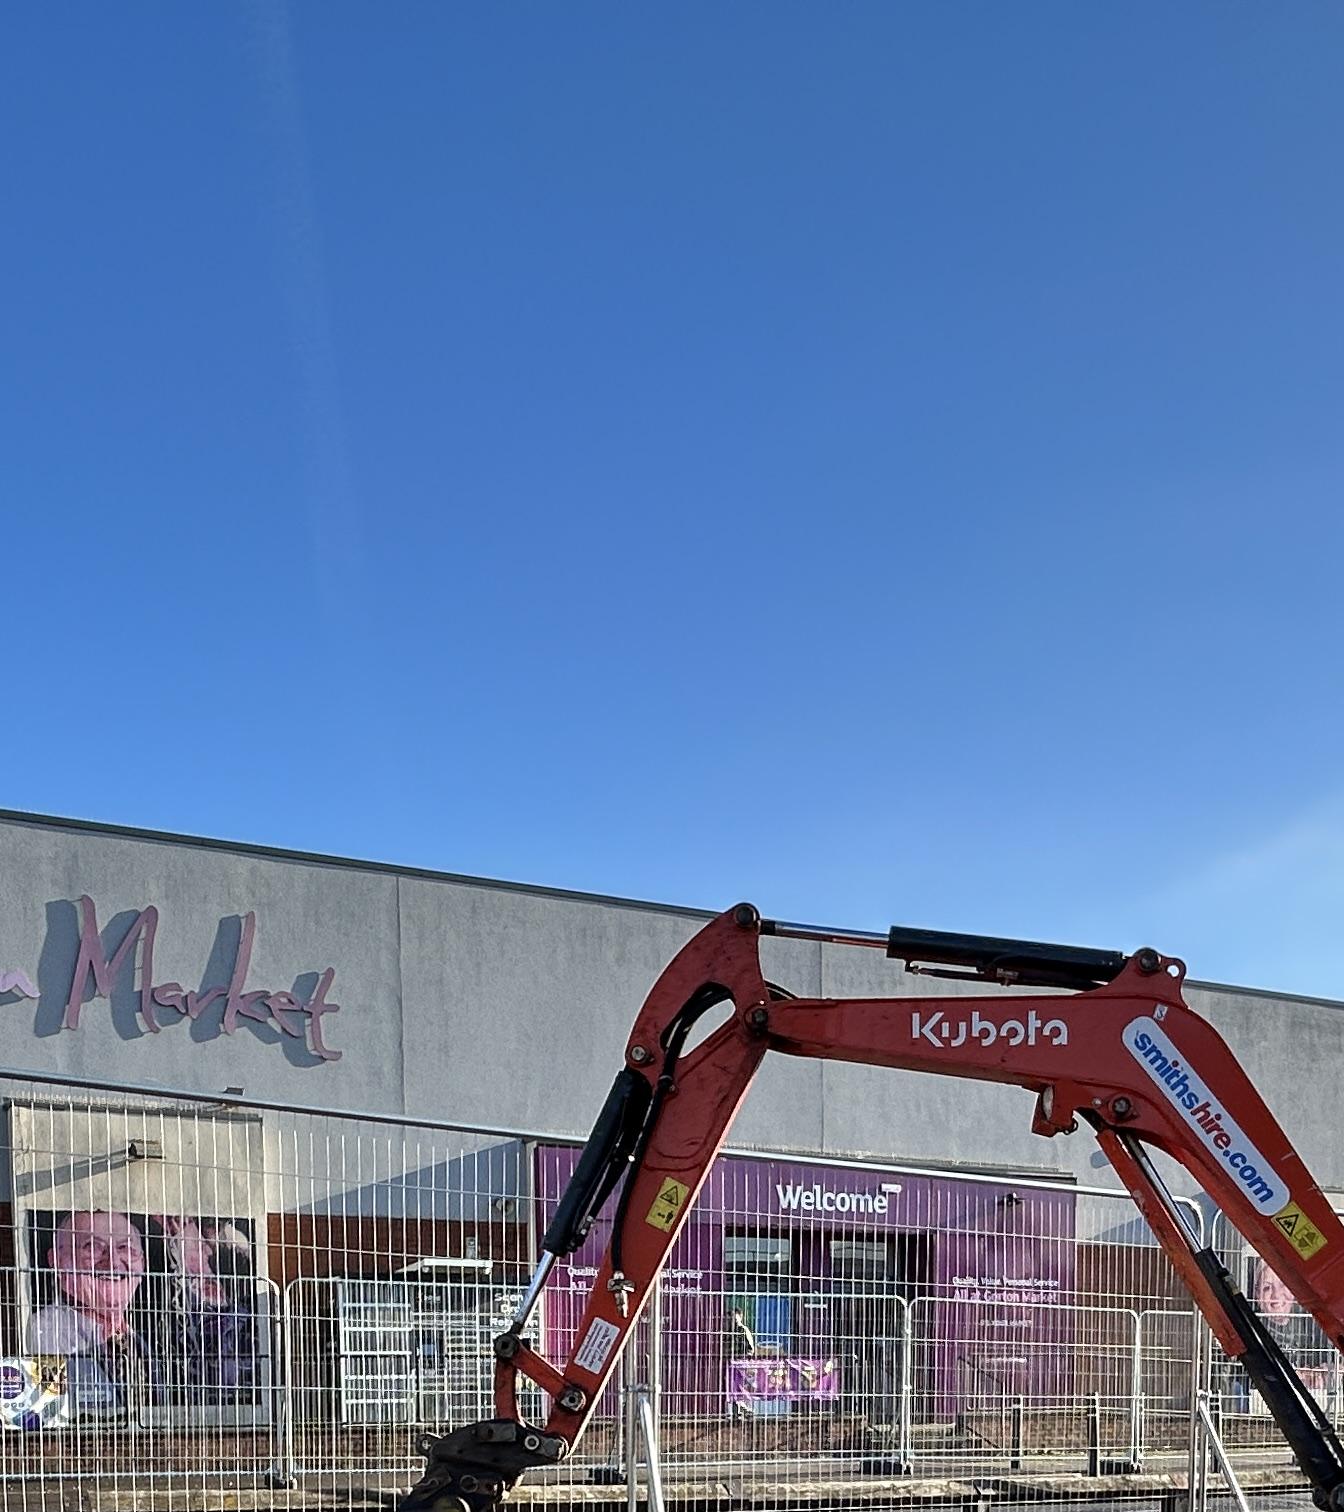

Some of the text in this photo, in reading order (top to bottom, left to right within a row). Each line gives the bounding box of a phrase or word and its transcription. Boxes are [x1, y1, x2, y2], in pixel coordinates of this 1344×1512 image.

[61, 894, 342, 1061] Market
[912, 1010, 1068, 1047] Kubota
[1134, 1032, 1274, 1203] smithshire.com
[776, 1184, 888, 1213] Welcome
